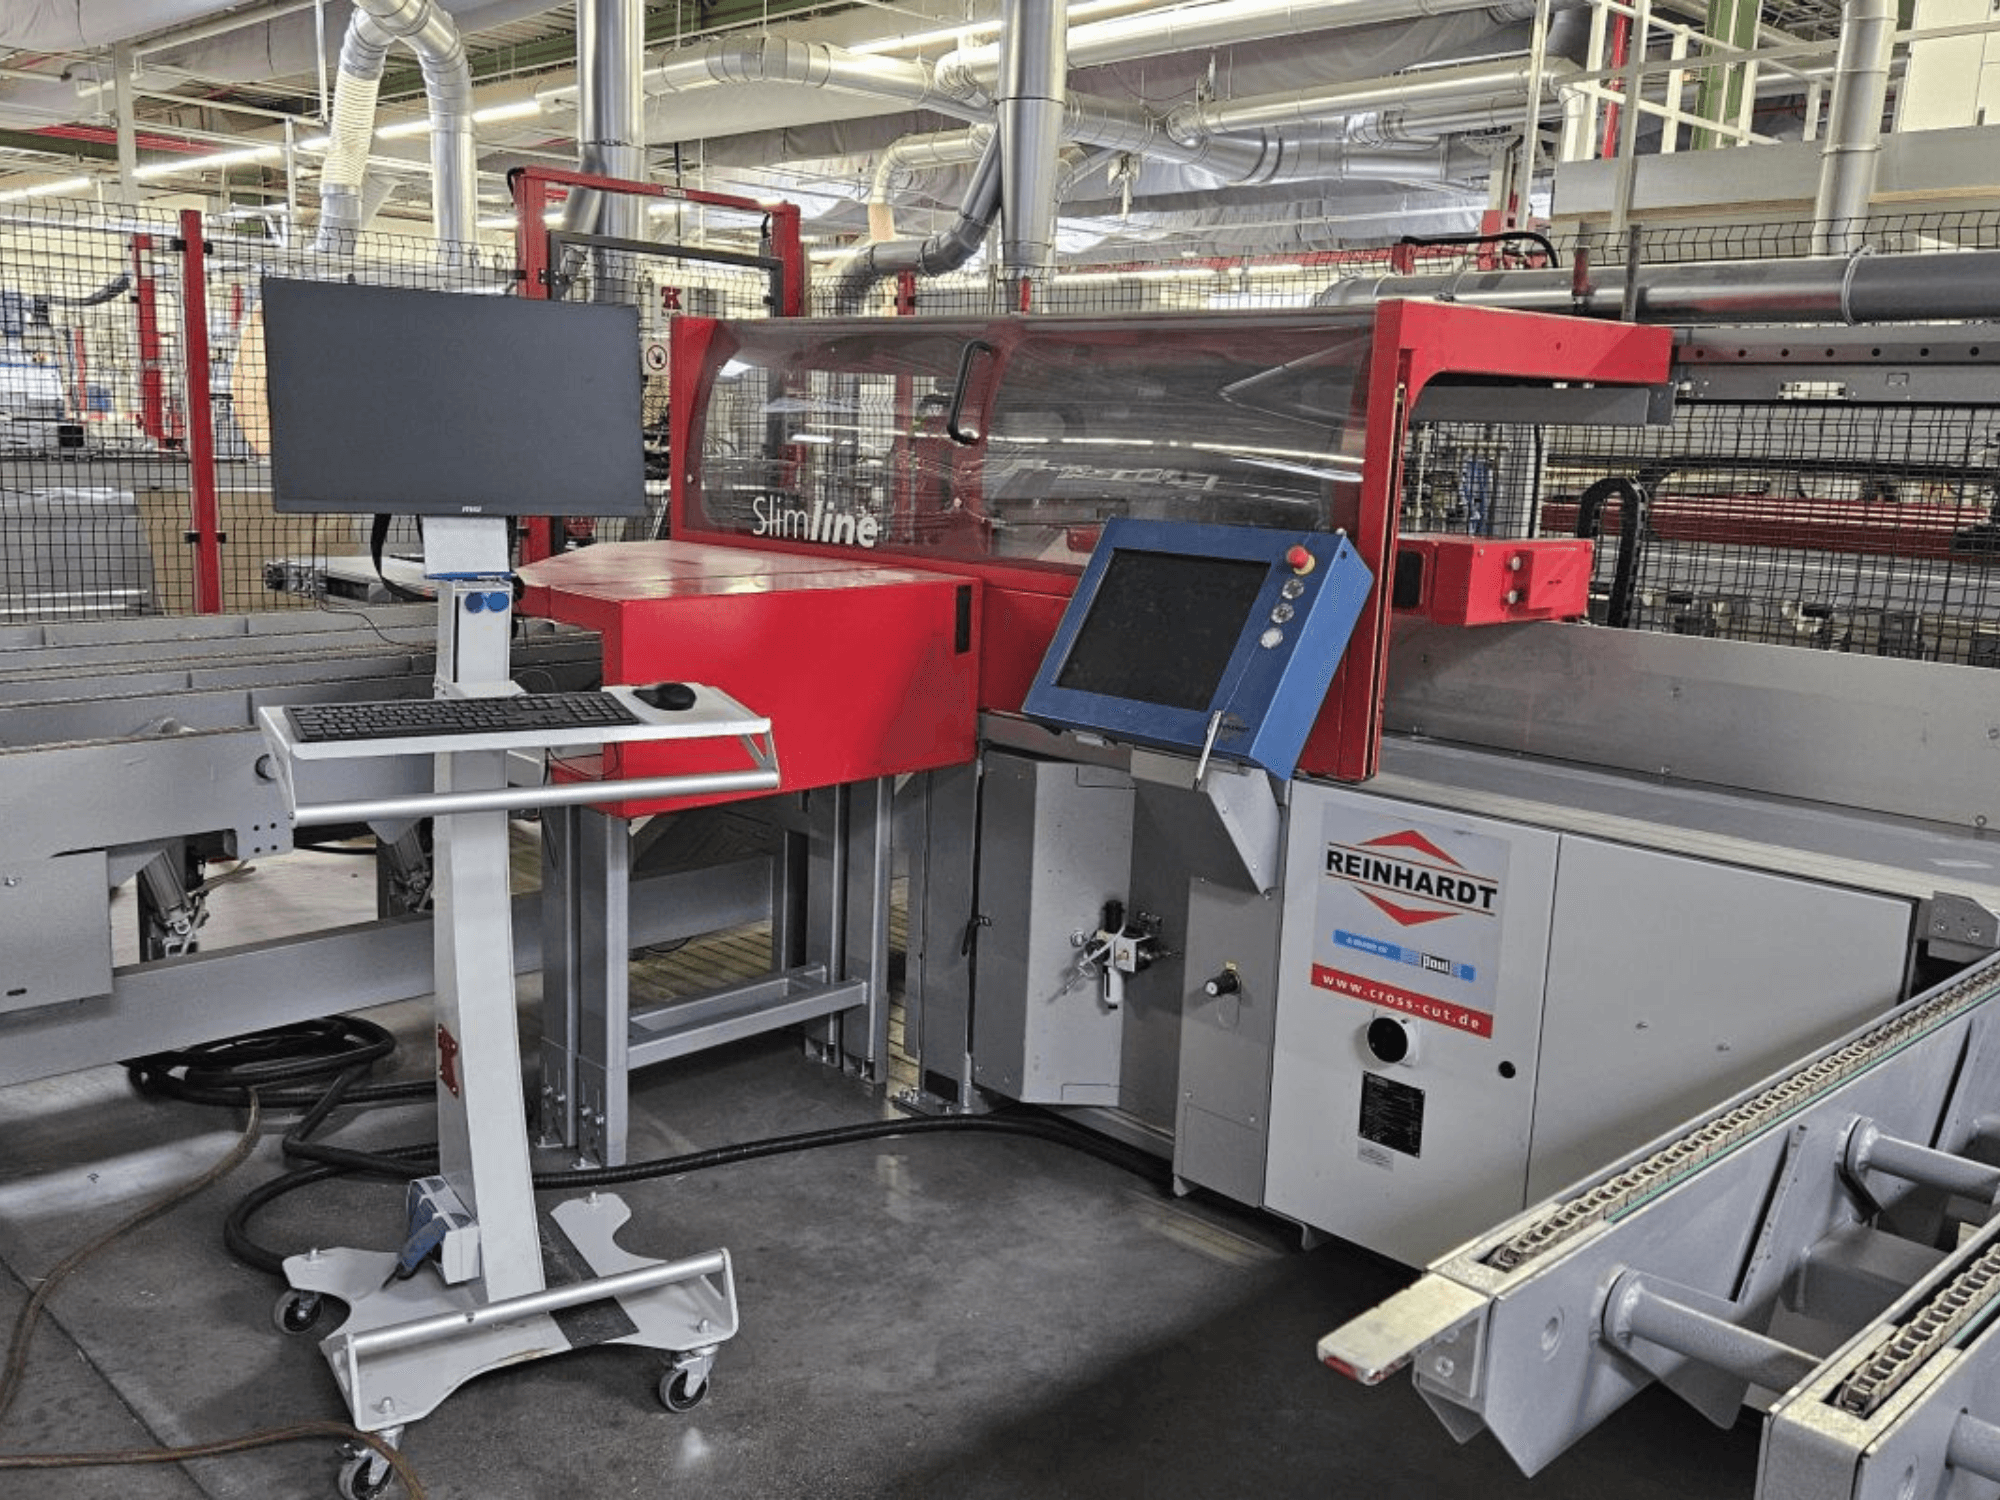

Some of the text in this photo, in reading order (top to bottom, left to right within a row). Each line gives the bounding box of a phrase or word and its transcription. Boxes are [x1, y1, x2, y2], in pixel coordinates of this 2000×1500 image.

[753, 495, 877, 548] Slimline
[1326, 849, 1498, 909] REINHARDT
[1323, 975, 1480, 1029] www.cross-cut.de
